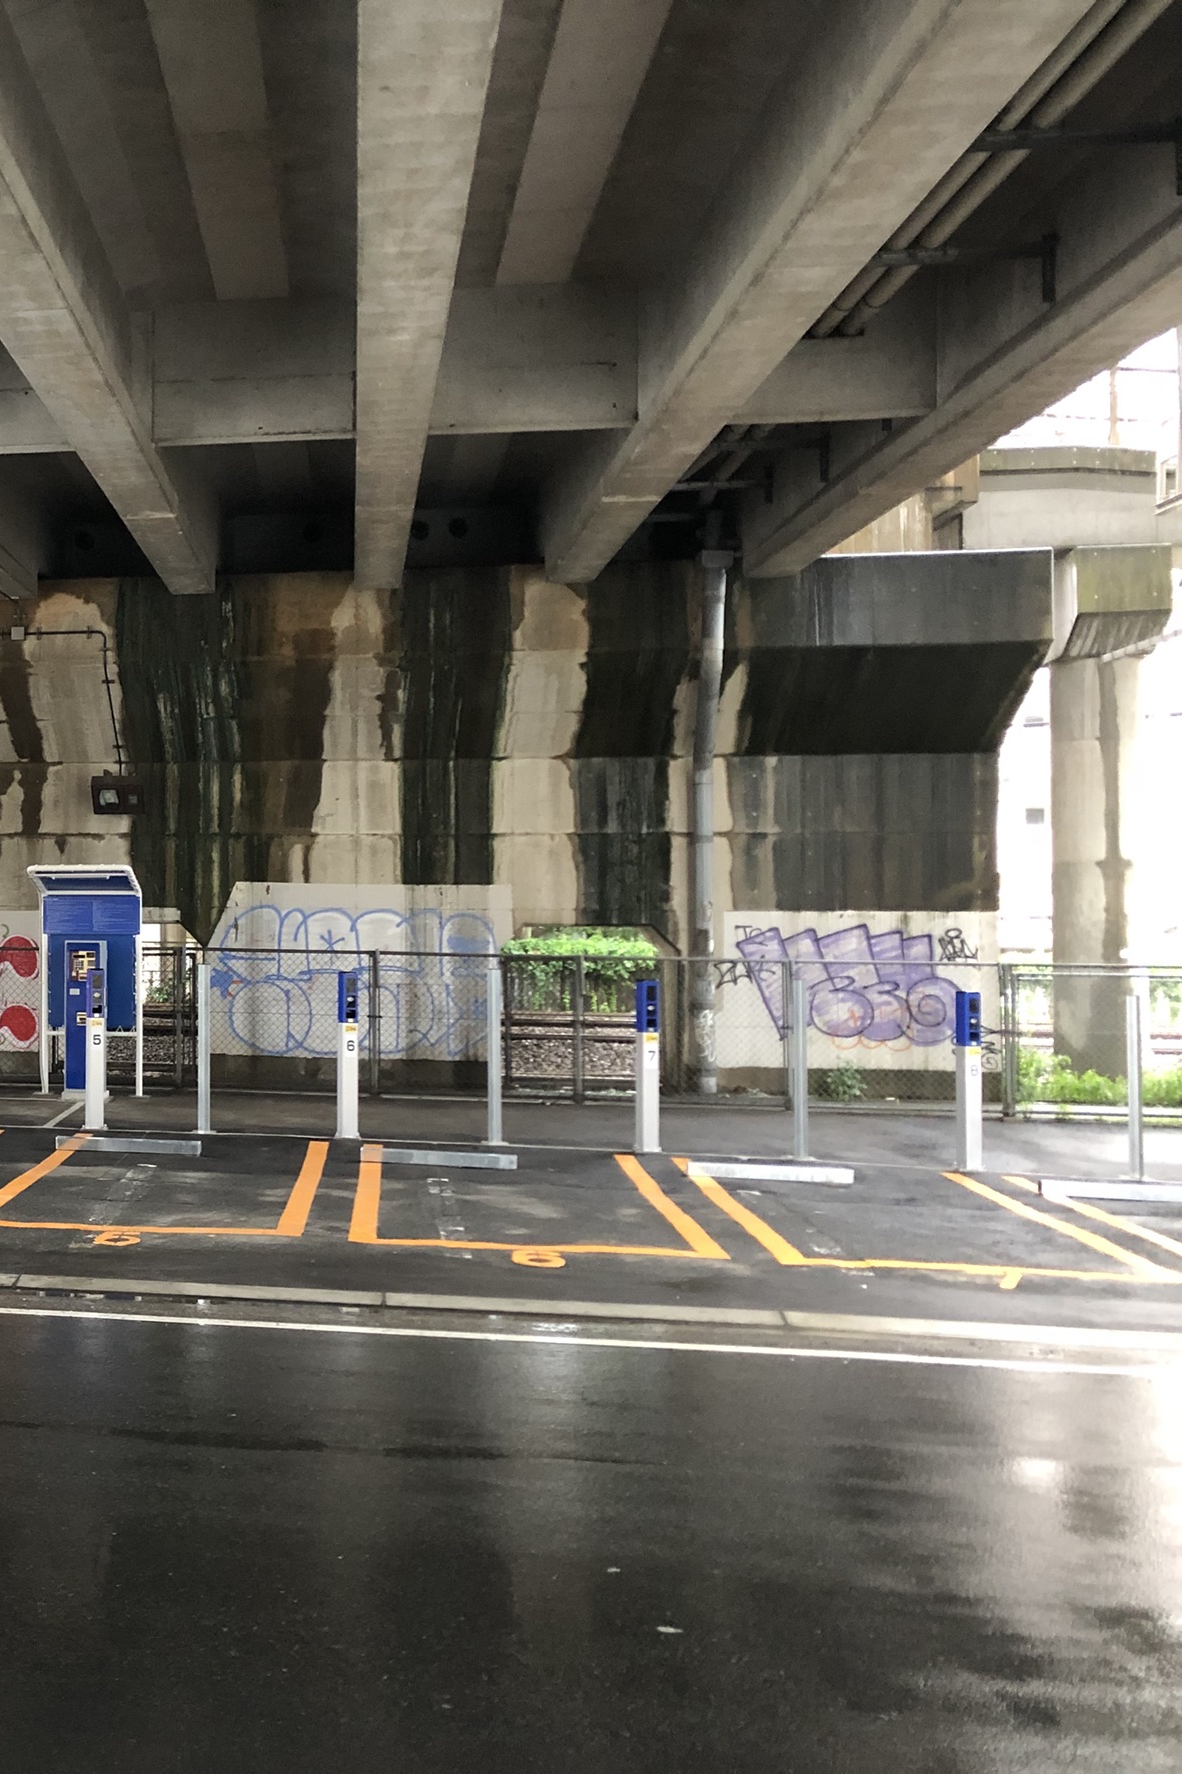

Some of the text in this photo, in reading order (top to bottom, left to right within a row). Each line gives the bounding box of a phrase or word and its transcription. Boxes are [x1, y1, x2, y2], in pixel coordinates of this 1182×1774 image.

[93, 1034, 101, 1045] 5
[347, 1040, 355, 1051] 6
[648, 1050, 656, 1061] 7
[970, 1064, 978, 1076] 8
[512, 1250, 566, 1268] 6
